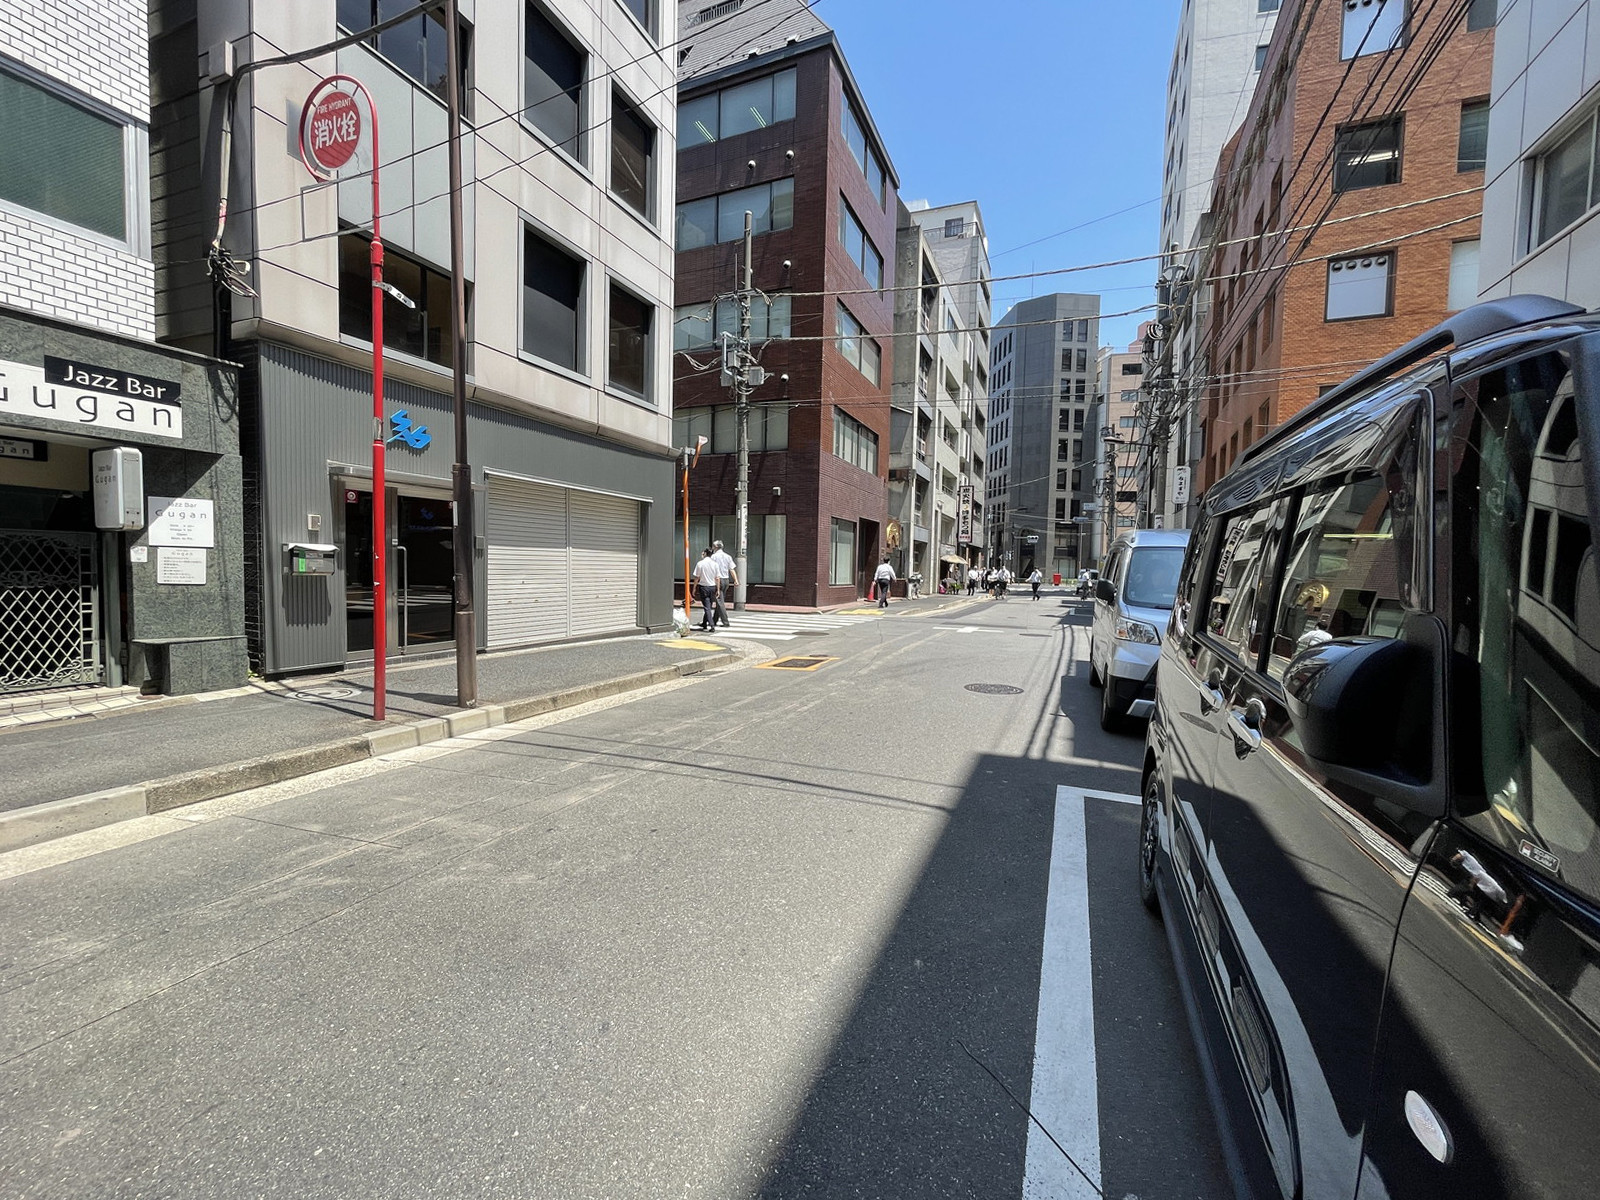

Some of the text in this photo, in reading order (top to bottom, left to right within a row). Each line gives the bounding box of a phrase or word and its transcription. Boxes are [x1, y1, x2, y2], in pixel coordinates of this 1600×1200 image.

[317, 97, 352, 115] FIRE HYDRANT
[314, 110, 357, 149] 消火栓
[63, 365, 167, 399] Jazz Bar
[95, 475, 117, 485] Gugan
[155, 509, 207, 520] Gugan
